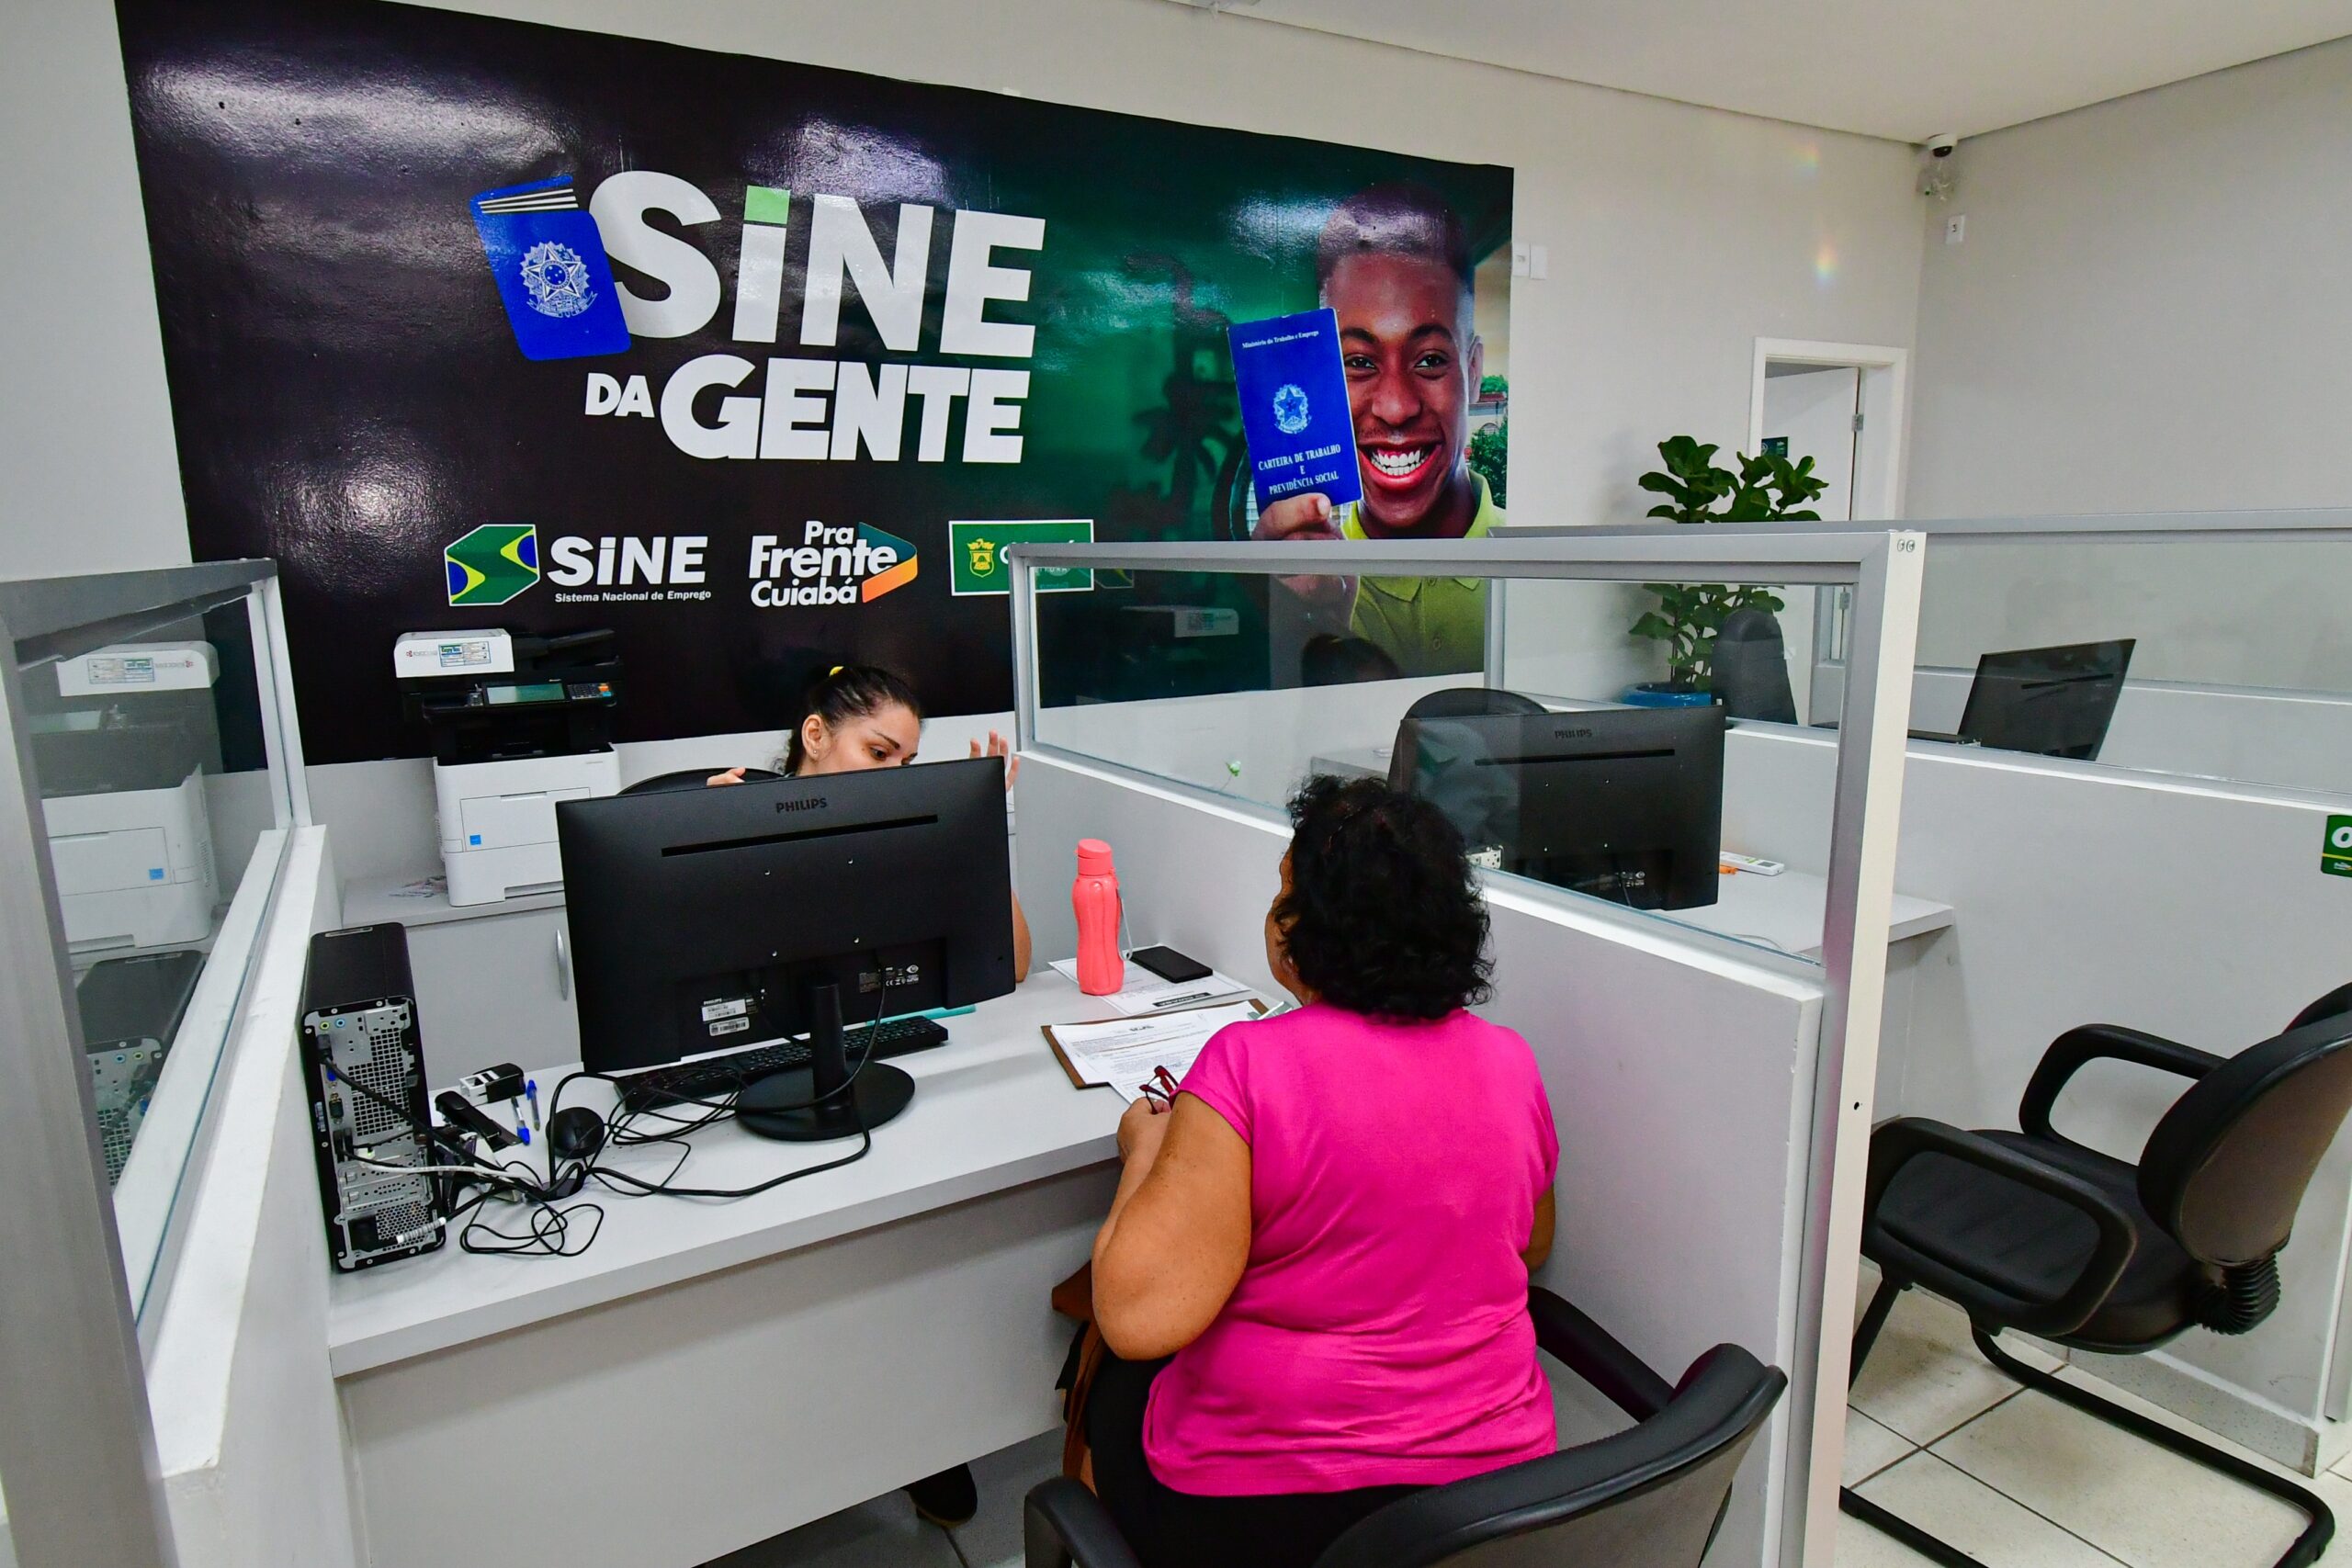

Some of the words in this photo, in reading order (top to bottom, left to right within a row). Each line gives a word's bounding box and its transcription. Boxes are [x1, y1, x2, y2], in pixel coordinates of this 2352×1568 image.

[584, 373, 655, 418] DA
[660, 354, 1030, 463] GENTE
[1258, 456, 1293, 470] CARTEIRA
[1294, 452, 1305, 463] DE
[1306, 444, 1341, 460] TRABALHO
[1269, 478, 1314, 495] PREVIDÊNCIA
[1315, 470, 1339, 484] SOCIAL
[1300, 465, 1306, 475] E
[804, 520, 854, 545] Pra
[749, 535, 898, 579] Frente
[555, 592, 599, 603] Sistema
[603, 591, 649, 601] Nacional
[650, 591, 664, 601] de
[667, 590, 712, 602] Emprego
[751, 577, 857, 608] Cuiabá
[775, 797, 828, 814] PHILIPS
